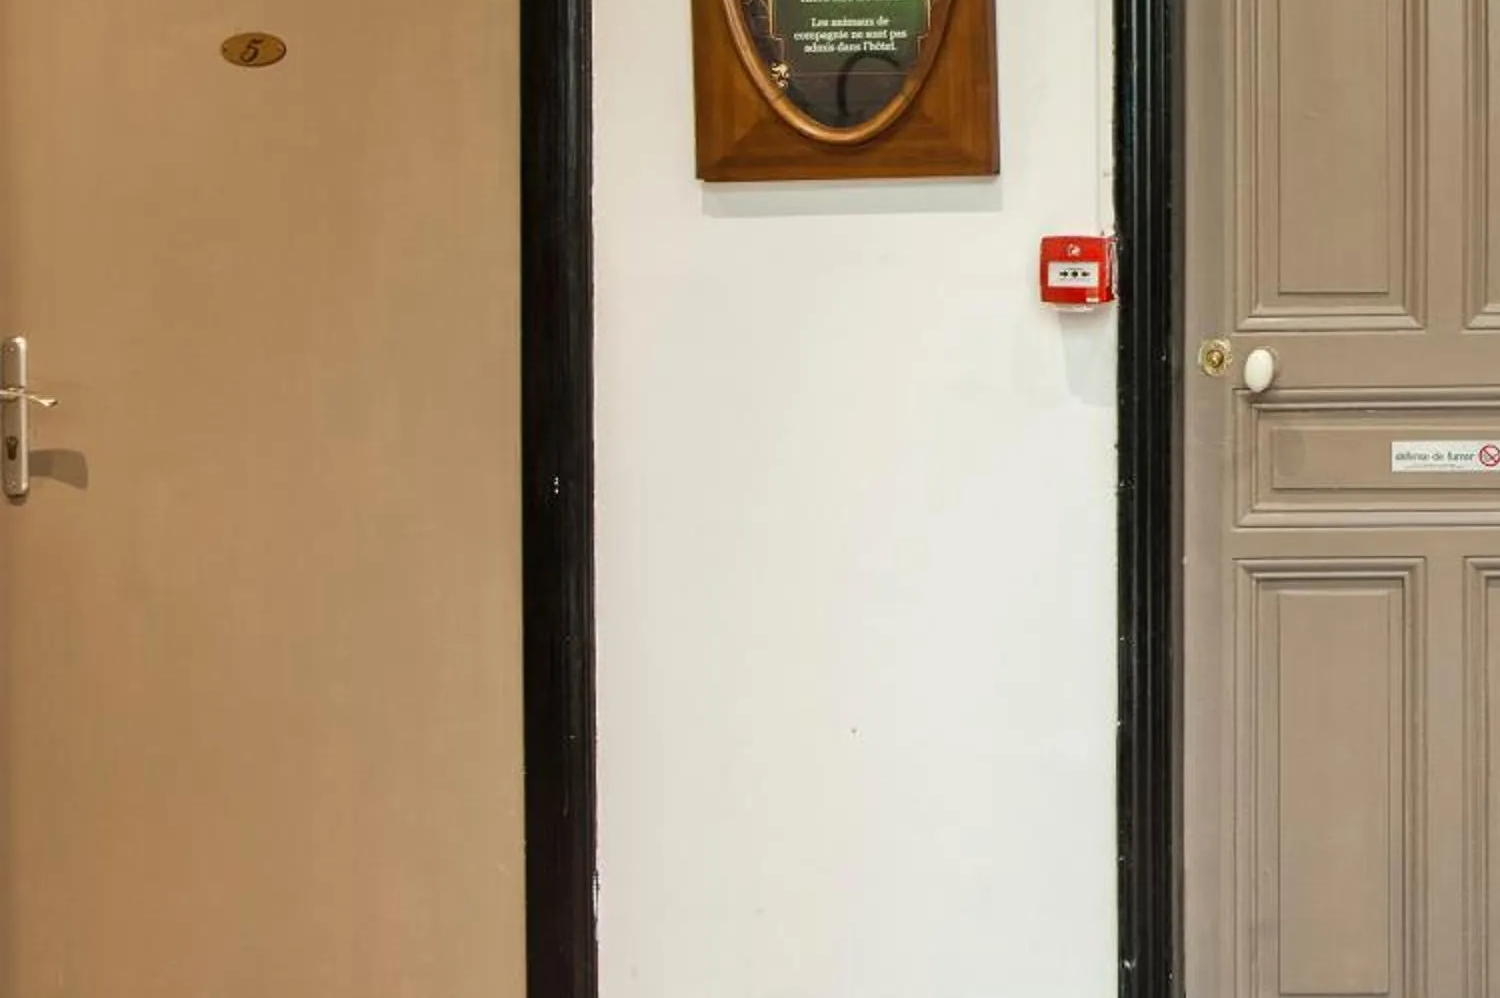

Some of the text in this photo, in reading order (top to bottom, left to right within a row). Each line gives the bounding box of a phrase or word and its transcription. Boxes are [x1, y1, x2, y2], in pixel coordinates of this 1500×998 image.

[793, 30, 849, 42] compagnie
[890, 30, 908, 42] pas
[240, 37, 264, 63] 5
